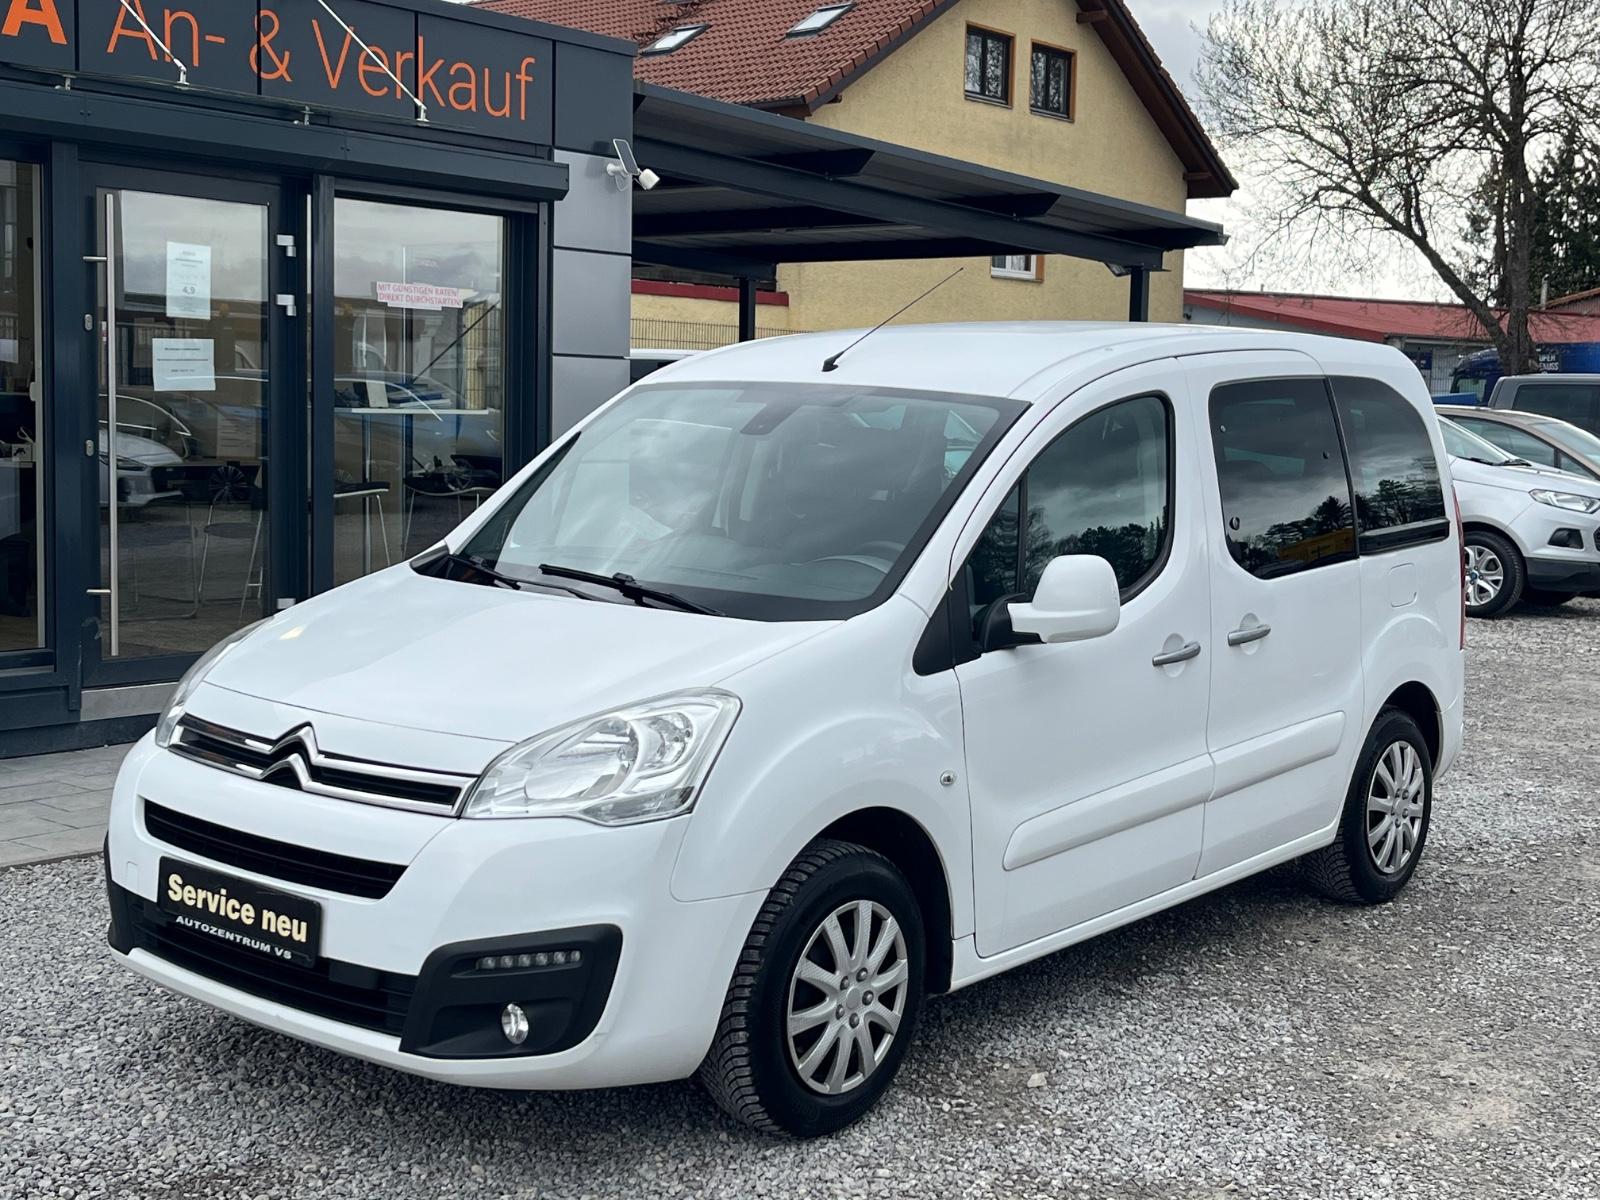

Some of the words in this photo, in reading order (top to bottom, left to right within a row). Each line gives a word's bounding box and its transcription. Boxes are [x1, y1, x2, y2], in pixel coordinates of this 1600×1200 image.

[106, 0, 226, 67] An-
[249, 9, 293, 82] &
[311, 19, 536, 121] Verkauf
[378, 283, 391, 292] MIT
[379, 292, 404, 301] DIREKT
[168, 873, 256, 925] Service
[261, 909, 307, 943] neu
[175, 915, 271, 953] AUTOZENTRUM
[274, 946, 292, 960] VS
